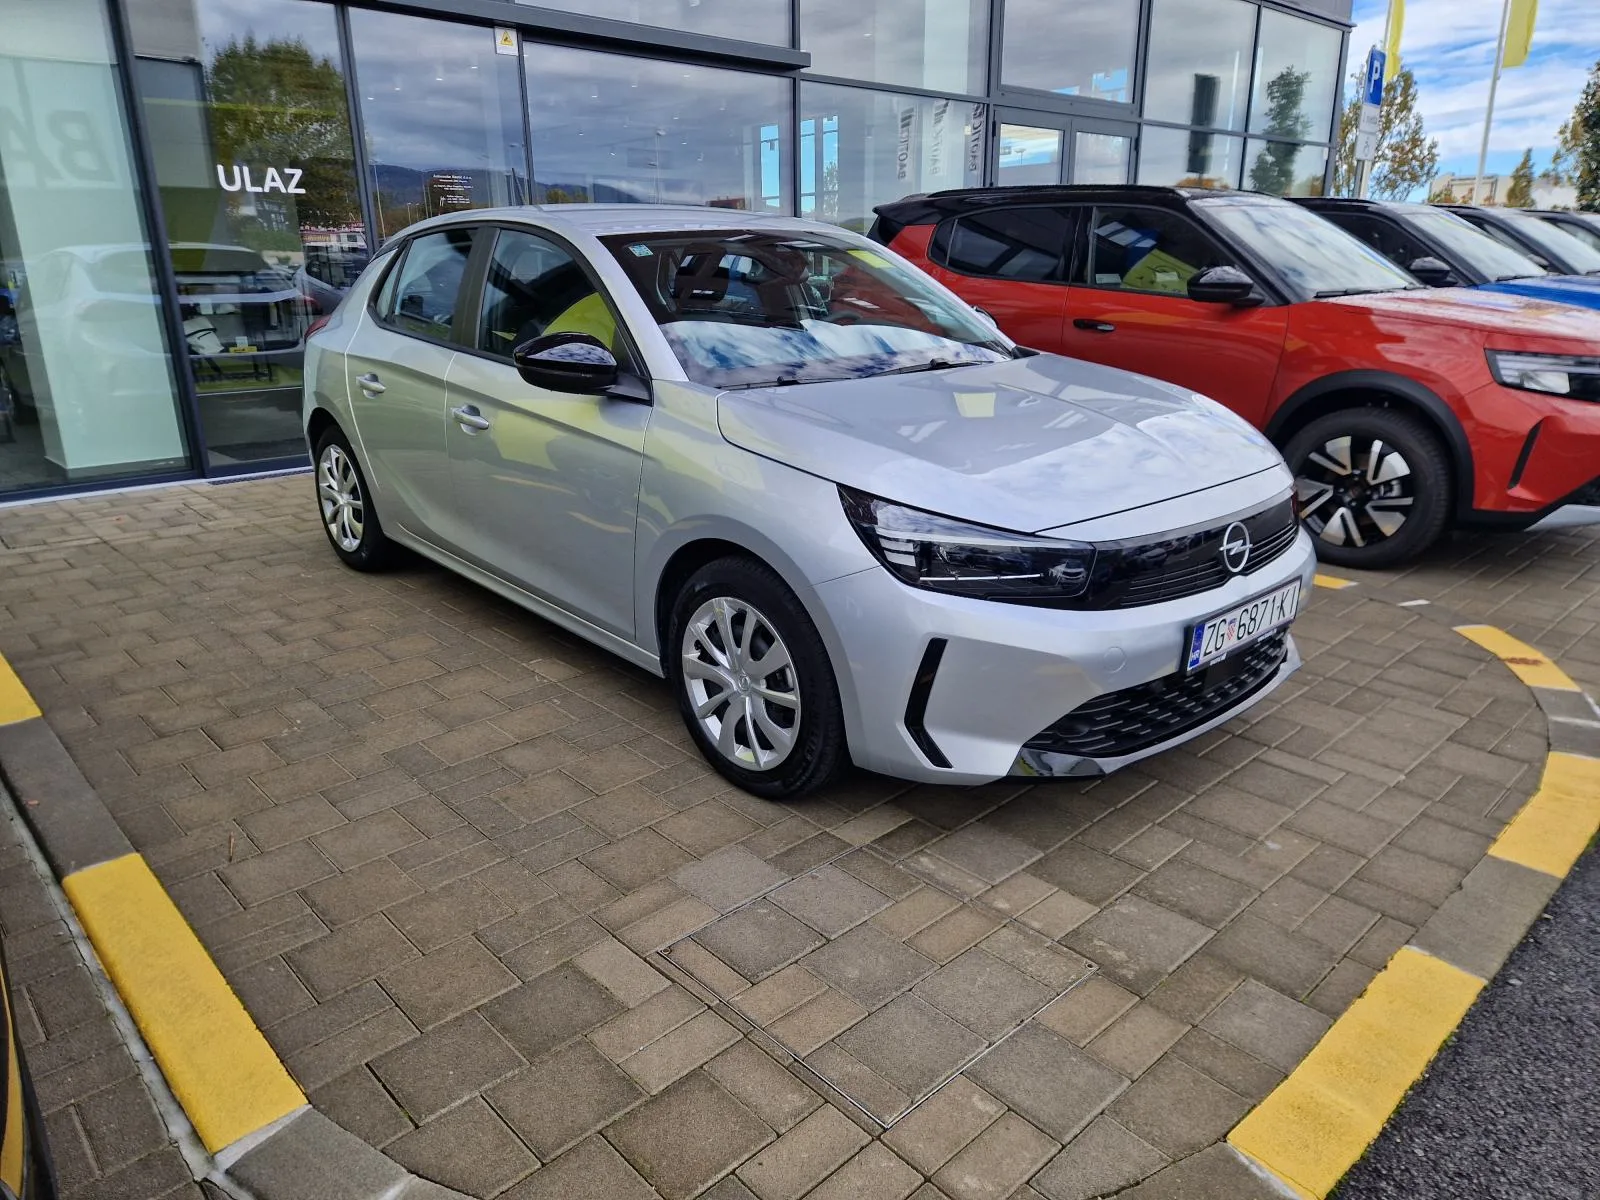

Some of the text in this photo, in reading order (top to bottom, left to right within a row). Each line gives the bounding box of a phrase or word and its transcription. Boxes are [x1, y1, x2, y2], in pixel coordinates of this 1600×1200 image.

[1369, 59, 1380, 93] P
[216, 164, 306, 194] ULAZ
[1203, 619, 1227, 656] ZG
